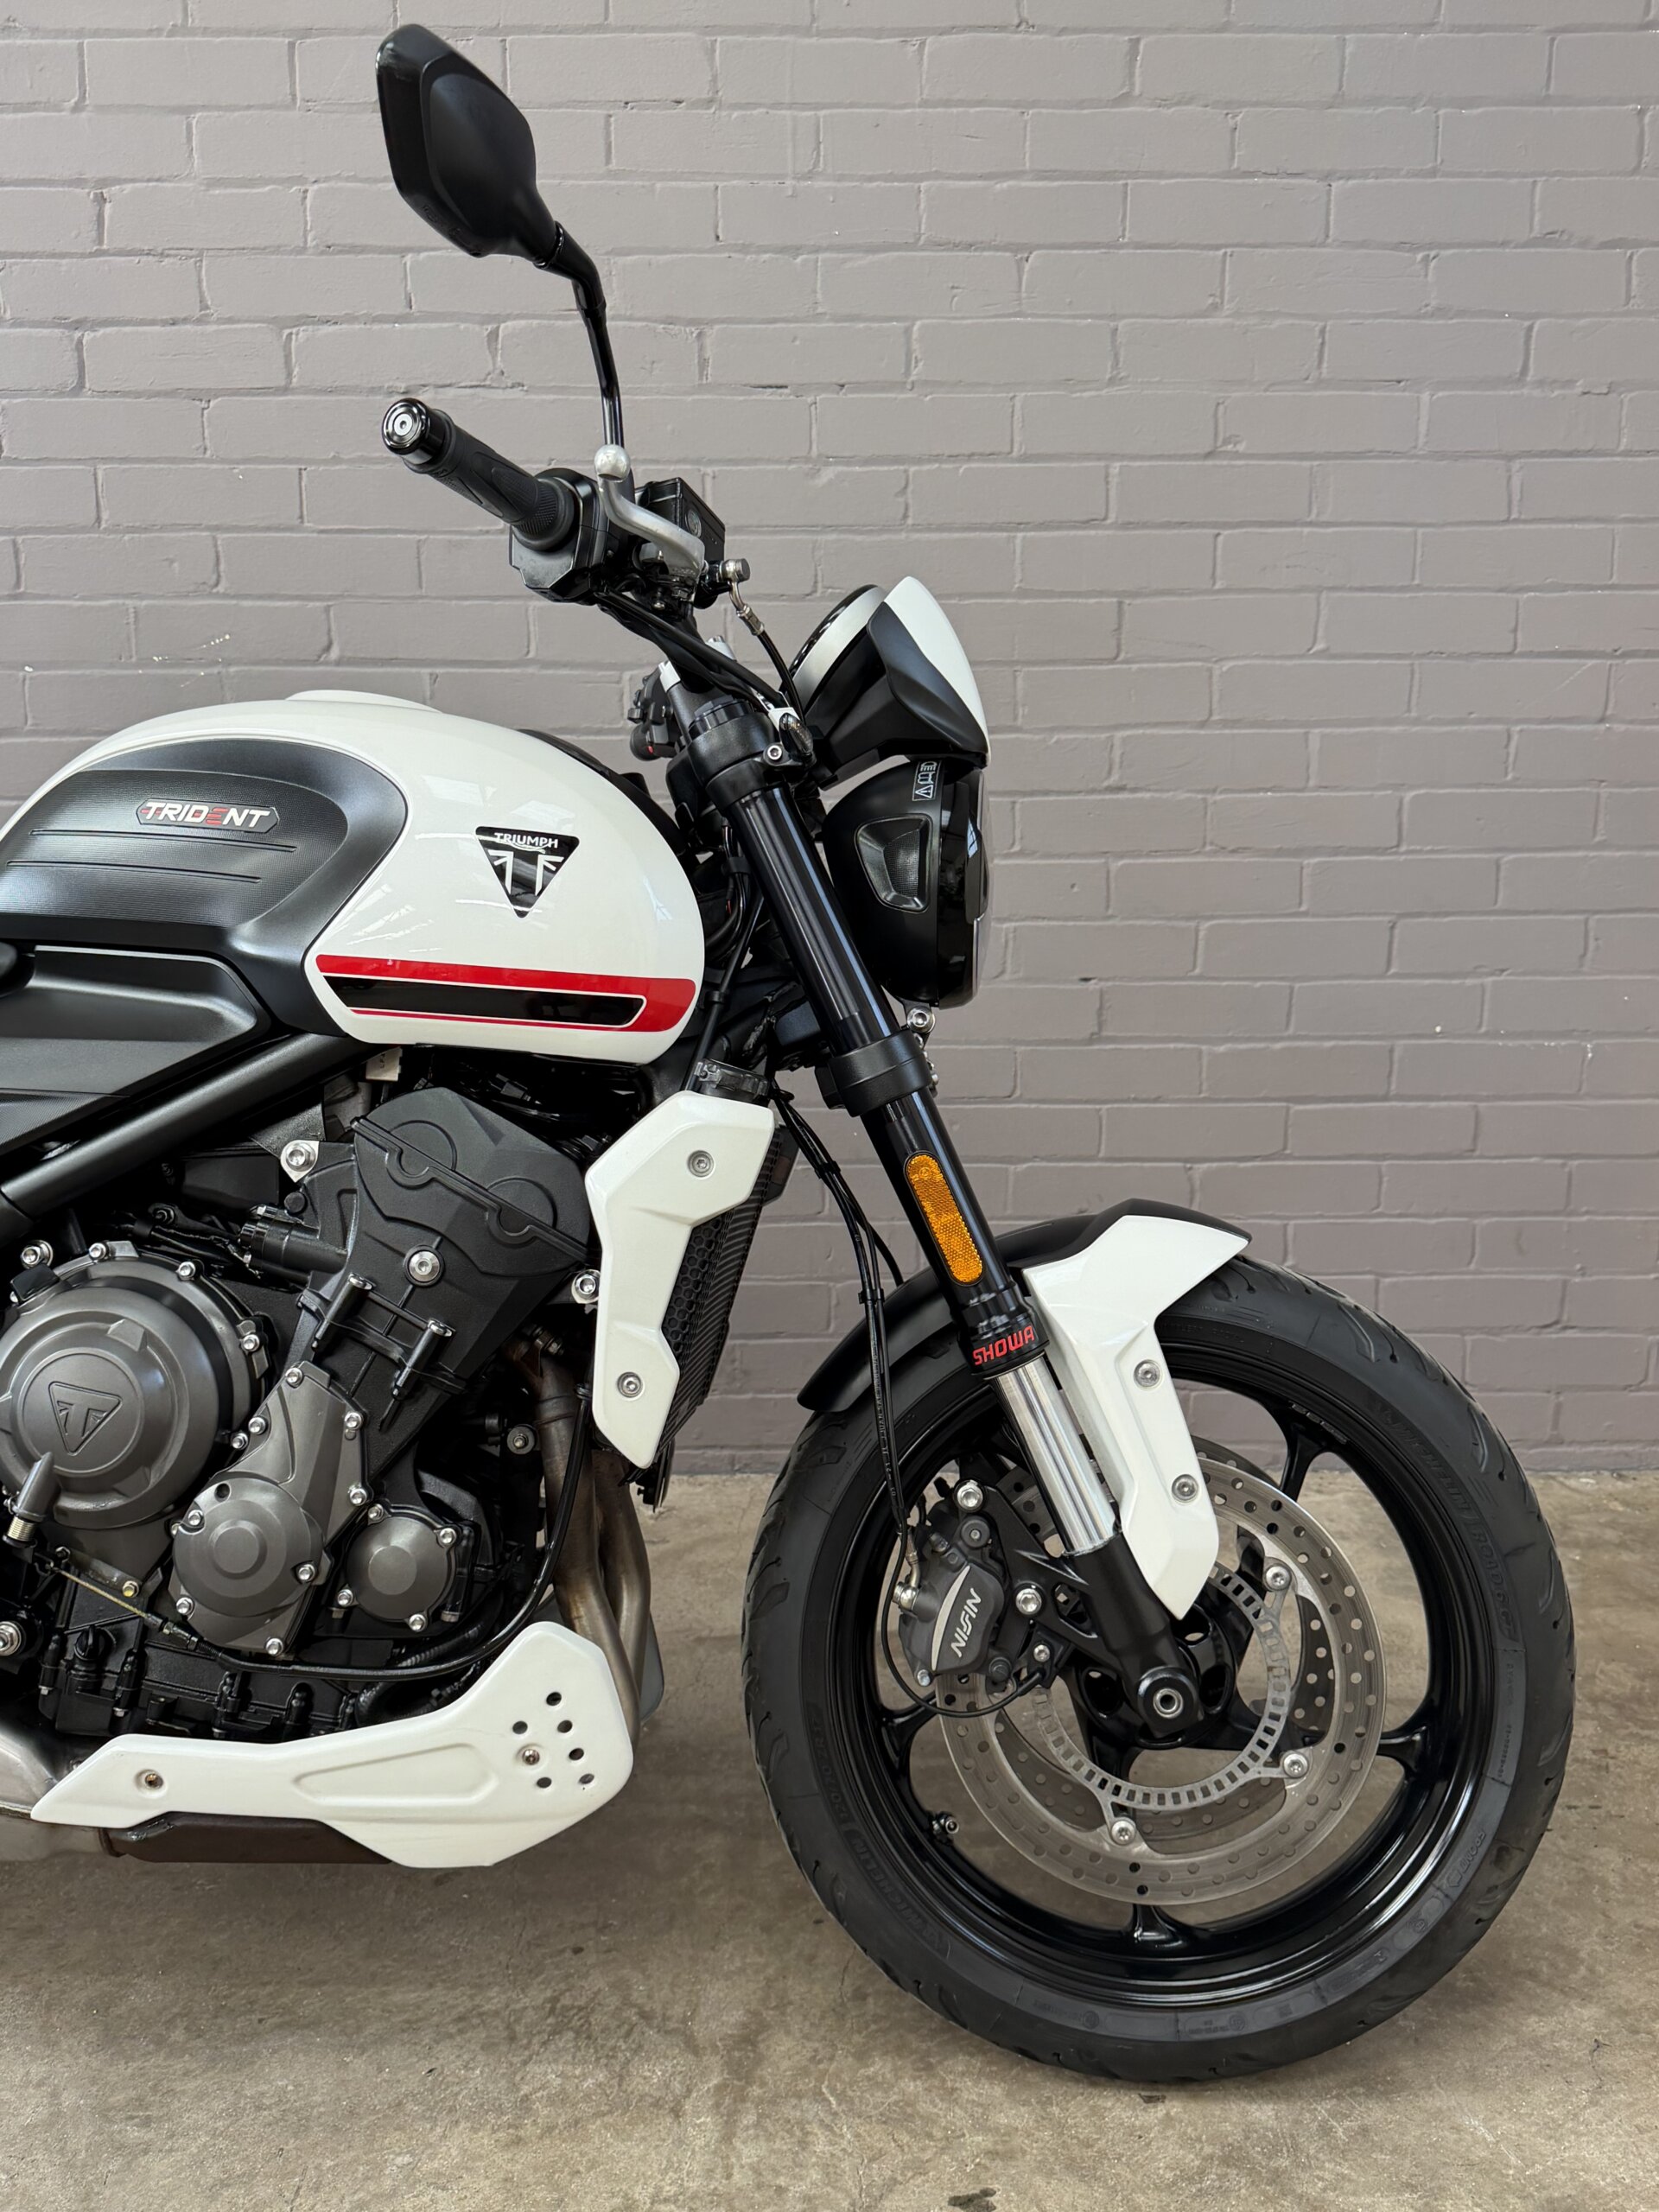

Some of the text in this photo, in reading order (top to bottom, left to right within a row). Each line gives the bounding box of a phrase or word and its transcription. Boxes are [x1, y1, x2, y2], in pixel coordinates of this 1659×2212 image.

[141, 801, 270, 828] TRIDENT
[494, 832, 558, 849] TRIUMPH
[972, 1325, 1035, 1365] SHOWA
[1389, 1417, 1471, 1514] MICHELIN
[1471, 1528, 1505, 1585] ROAD
[950, 1588, 982, 1658] NISSIN
[1456, 1828, 1489, 1873] FRONT
[848, 1834, 926, 1929] MICHELIN
